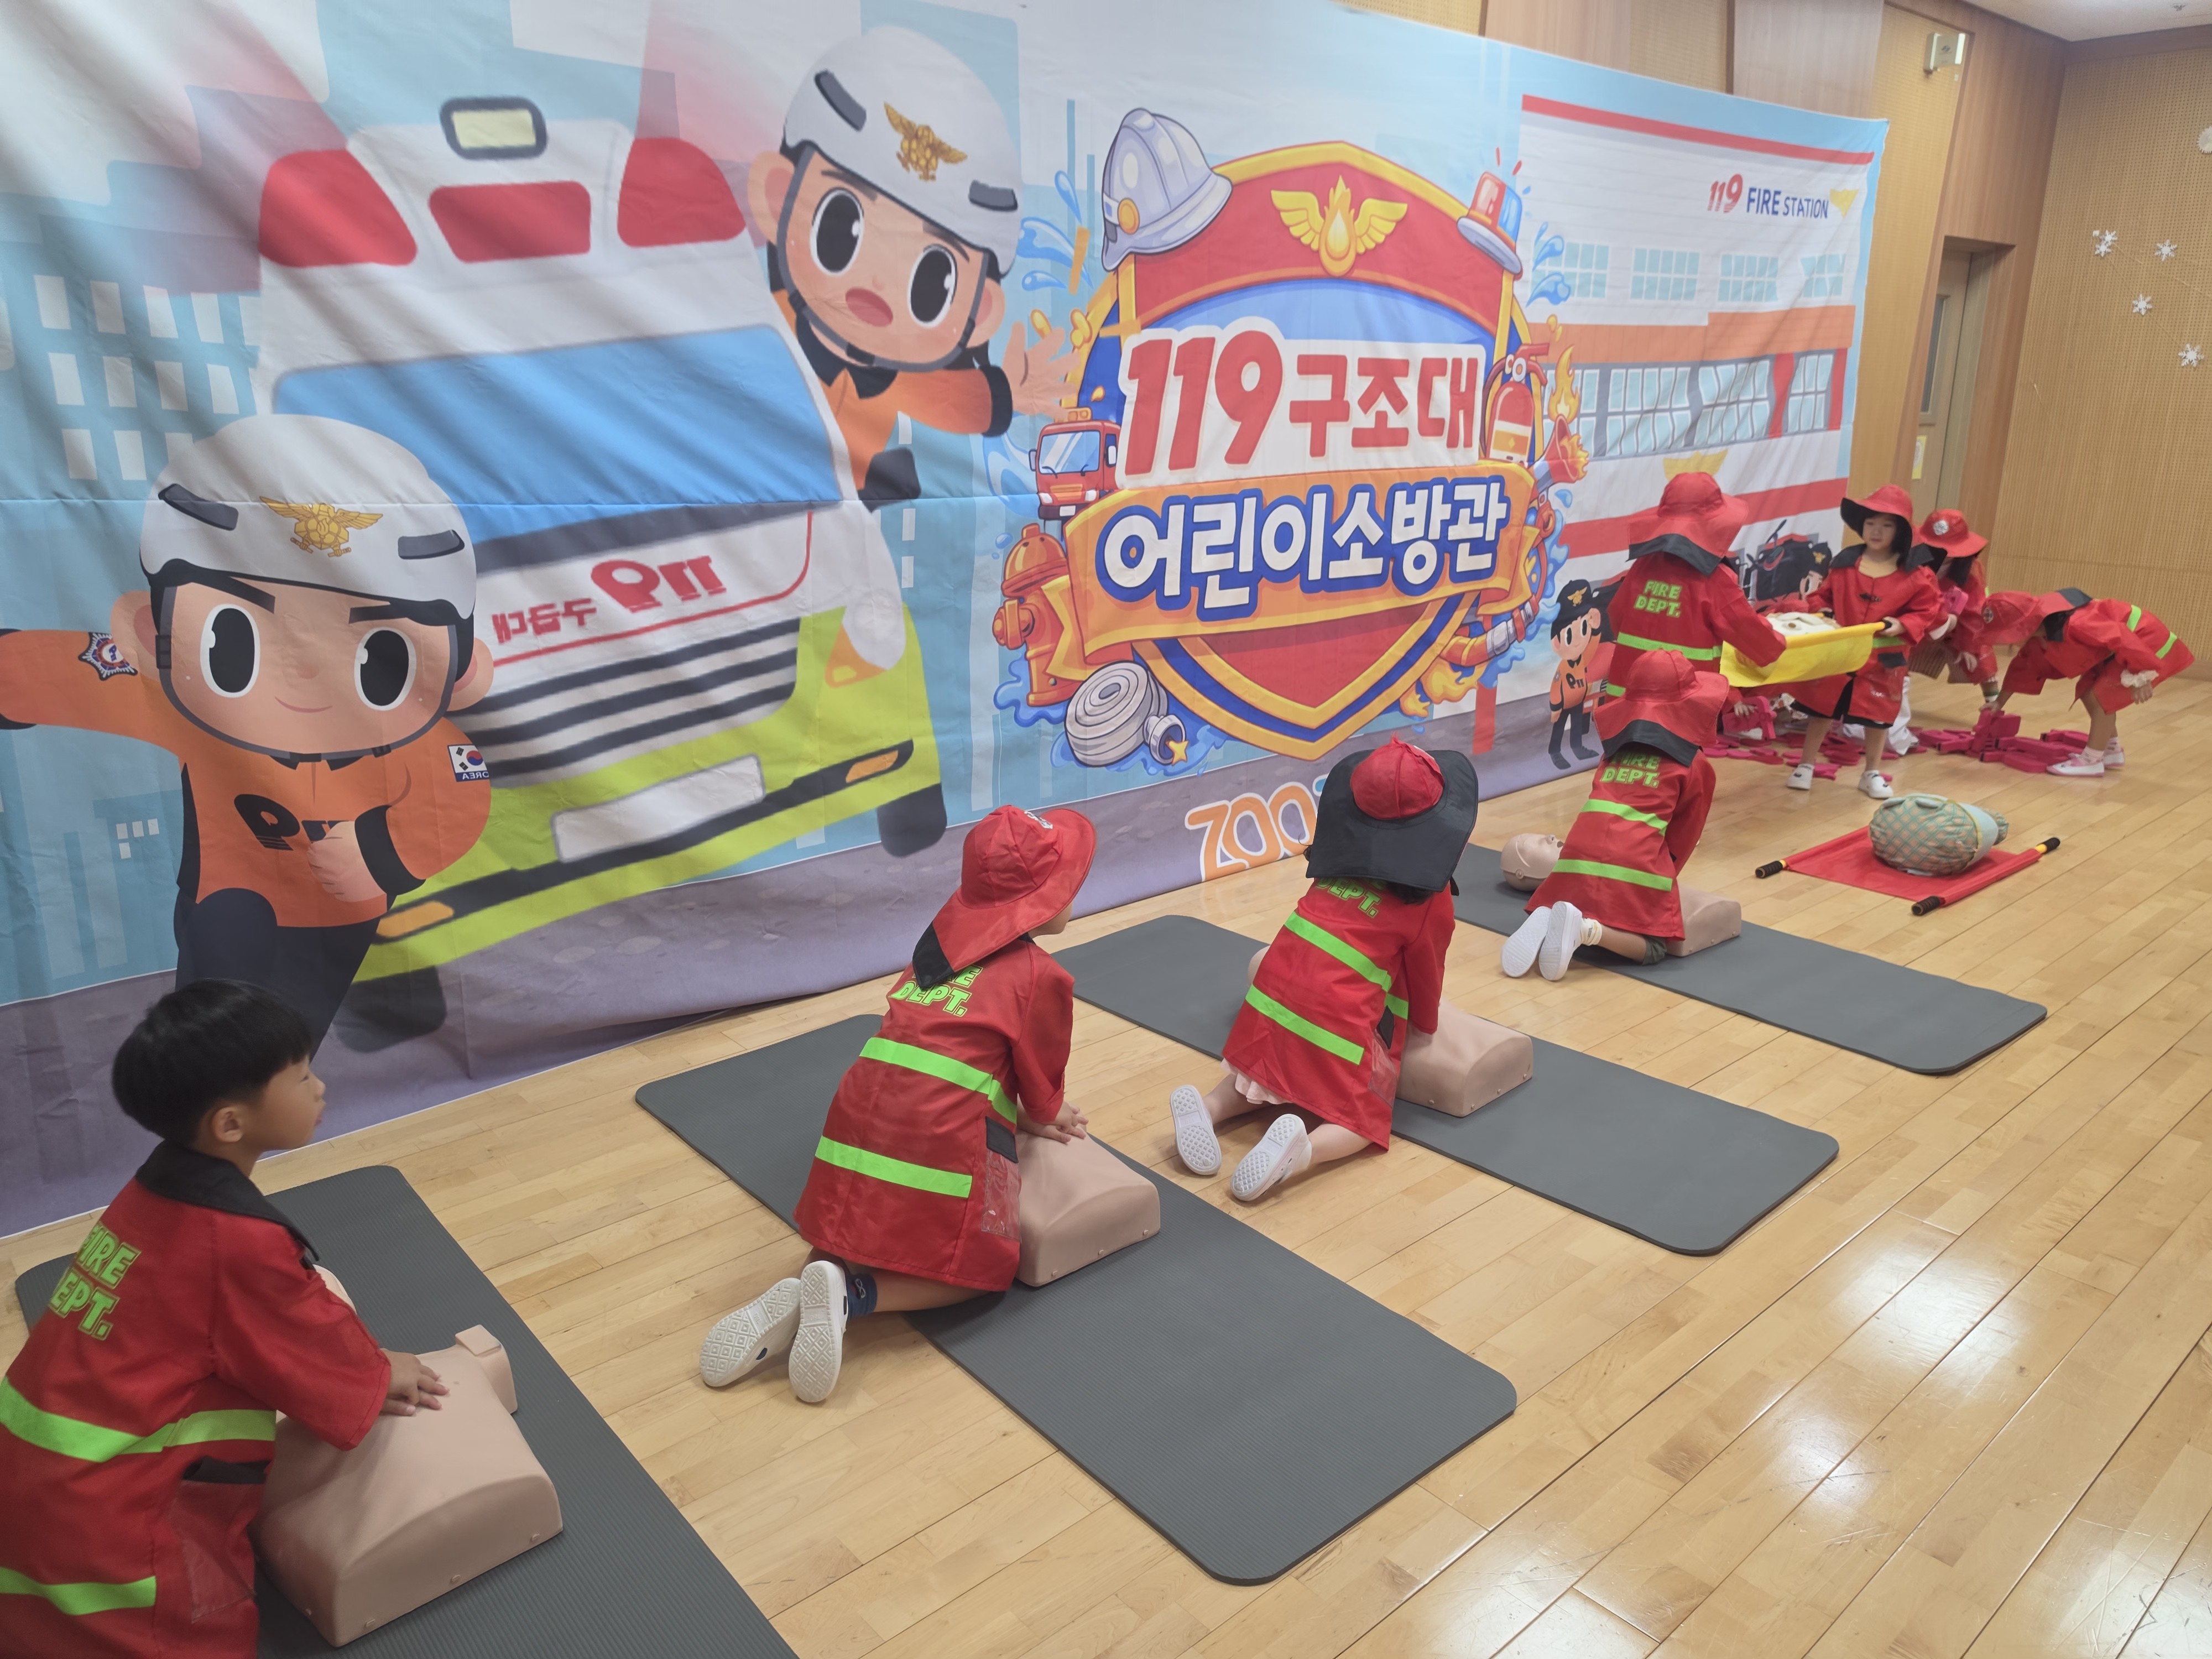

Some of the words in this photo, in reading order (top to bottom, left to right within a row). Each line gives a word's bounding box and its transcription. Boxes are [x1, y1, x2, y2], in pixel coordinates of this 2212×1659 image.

[1707, 173, 1744, 214] 119
[1746, 187, 1782, 216] FIRE
[1782, 196, 1829, 219] STATION
[1124, 330, 1284, 476] 119
[1104, 481, 1507, 609] 어린이소방관
[1634, 594, 1681, 618] DEPT.
[1644, 580, 1682, 599] FIRE
[1600, 766, 1660, 788] DEPT.
[888, 980, 973, 1018] DEPT.
[48, 1266, 121, 1341] EPT.
